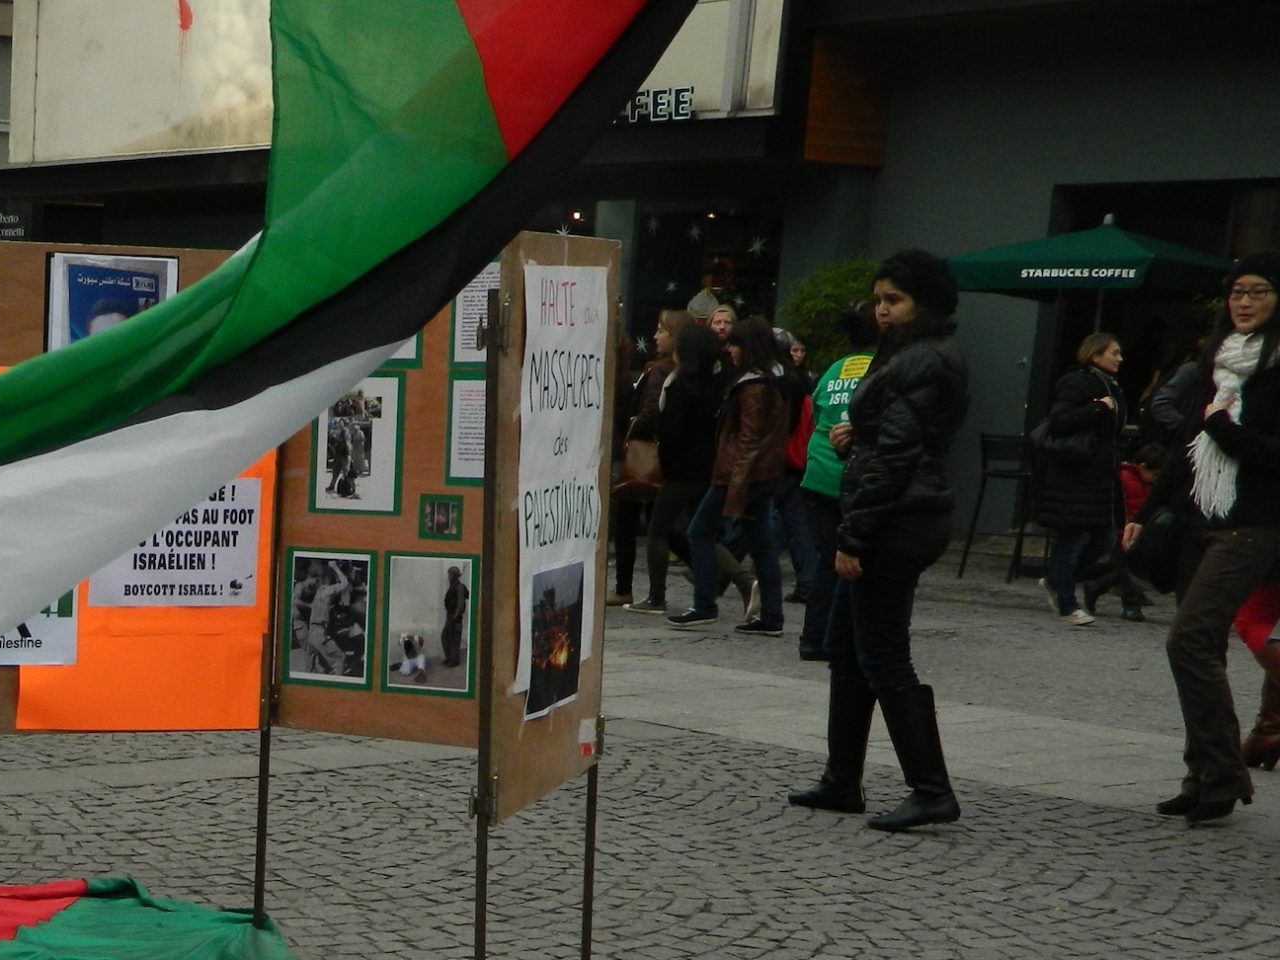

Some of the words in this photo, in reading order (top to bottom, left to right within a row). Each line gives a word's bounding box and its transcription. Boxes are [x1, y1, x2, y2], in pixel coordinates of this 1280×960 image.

[628, 87, 694, 122] FEE
[1021, 268, 1089, 278] STARBUCKS
[1091, 268, 1136, 278] COFFEE
[540, 278, 577, 328] HALTE
[529, 349, 601, 413] MASSACRES
[202, 509, 219, 525] AU
[223, 509, 255, 525] FOOT
[152, 530, 239, 548] L'OCCUPANT
[133, 548, 206, 571] ISRAÉLIEN
[124, 584, 176, 597] BOYCOTT
[178, 584, 218, 596] ISRAEL
